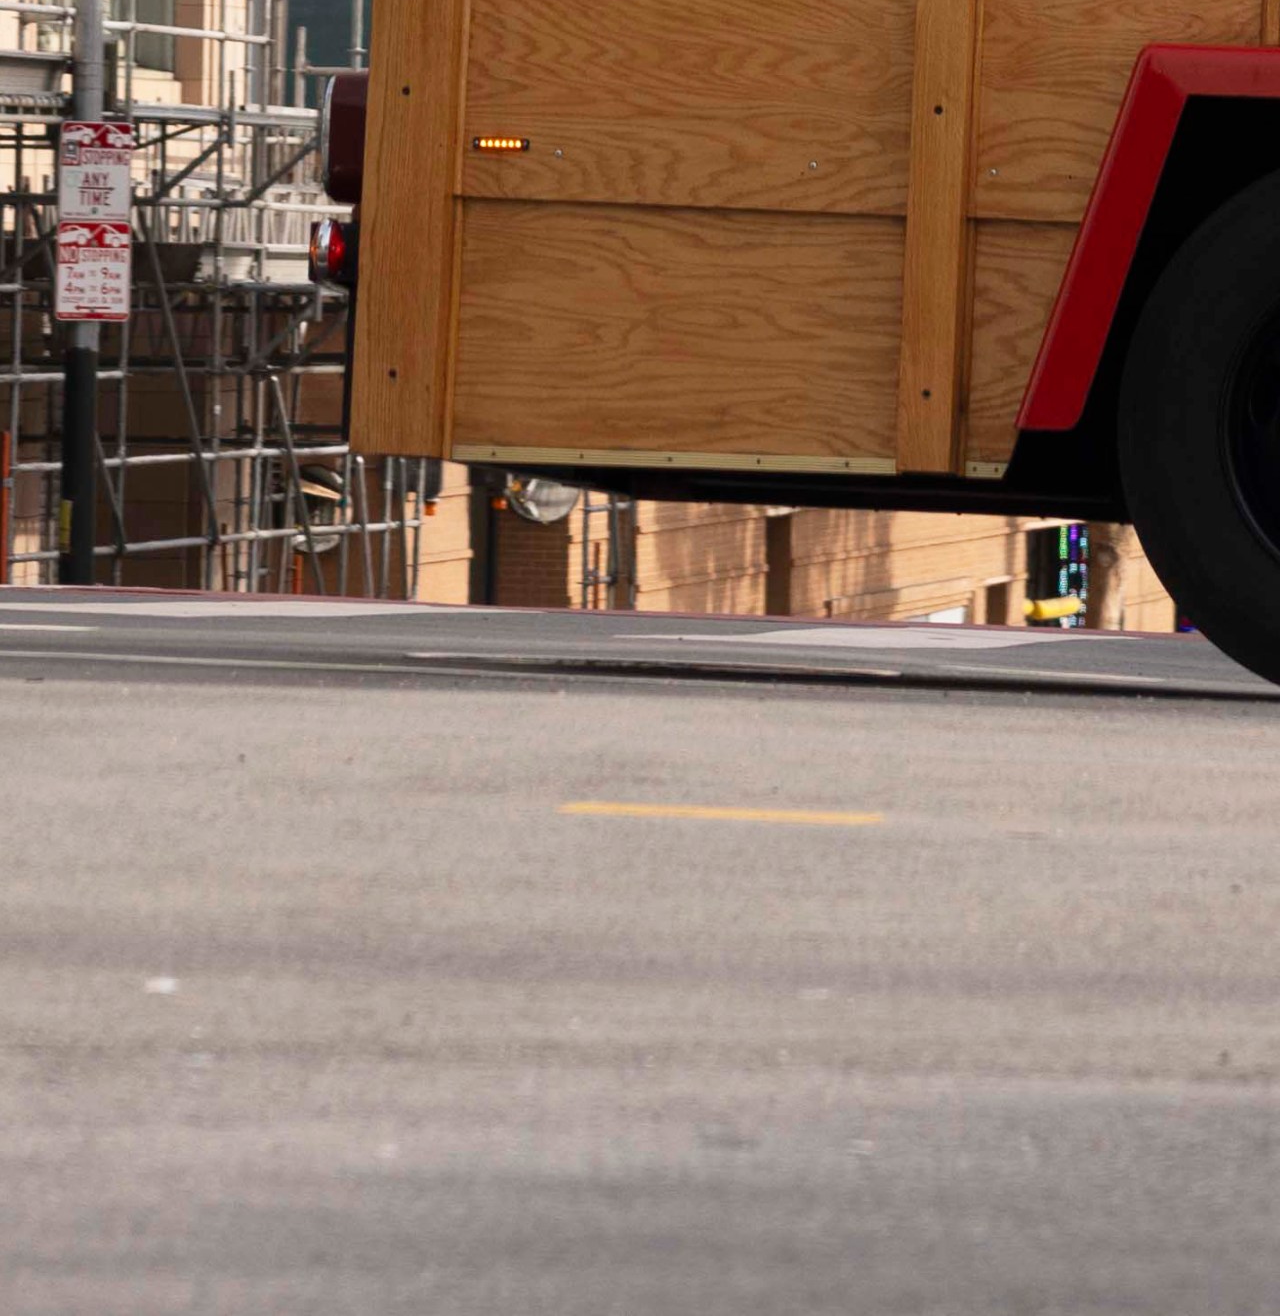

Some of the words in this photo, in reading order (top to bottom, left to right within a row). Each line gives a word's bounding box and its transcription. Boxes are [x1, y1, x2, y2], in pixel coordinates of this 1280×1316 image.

[81, 150, 129, 166] STOPPING
[82, 171, 110, 187] ANY
[79, 190, 112, 207] TIME
[80, 249, 127, 263] STOPPING
